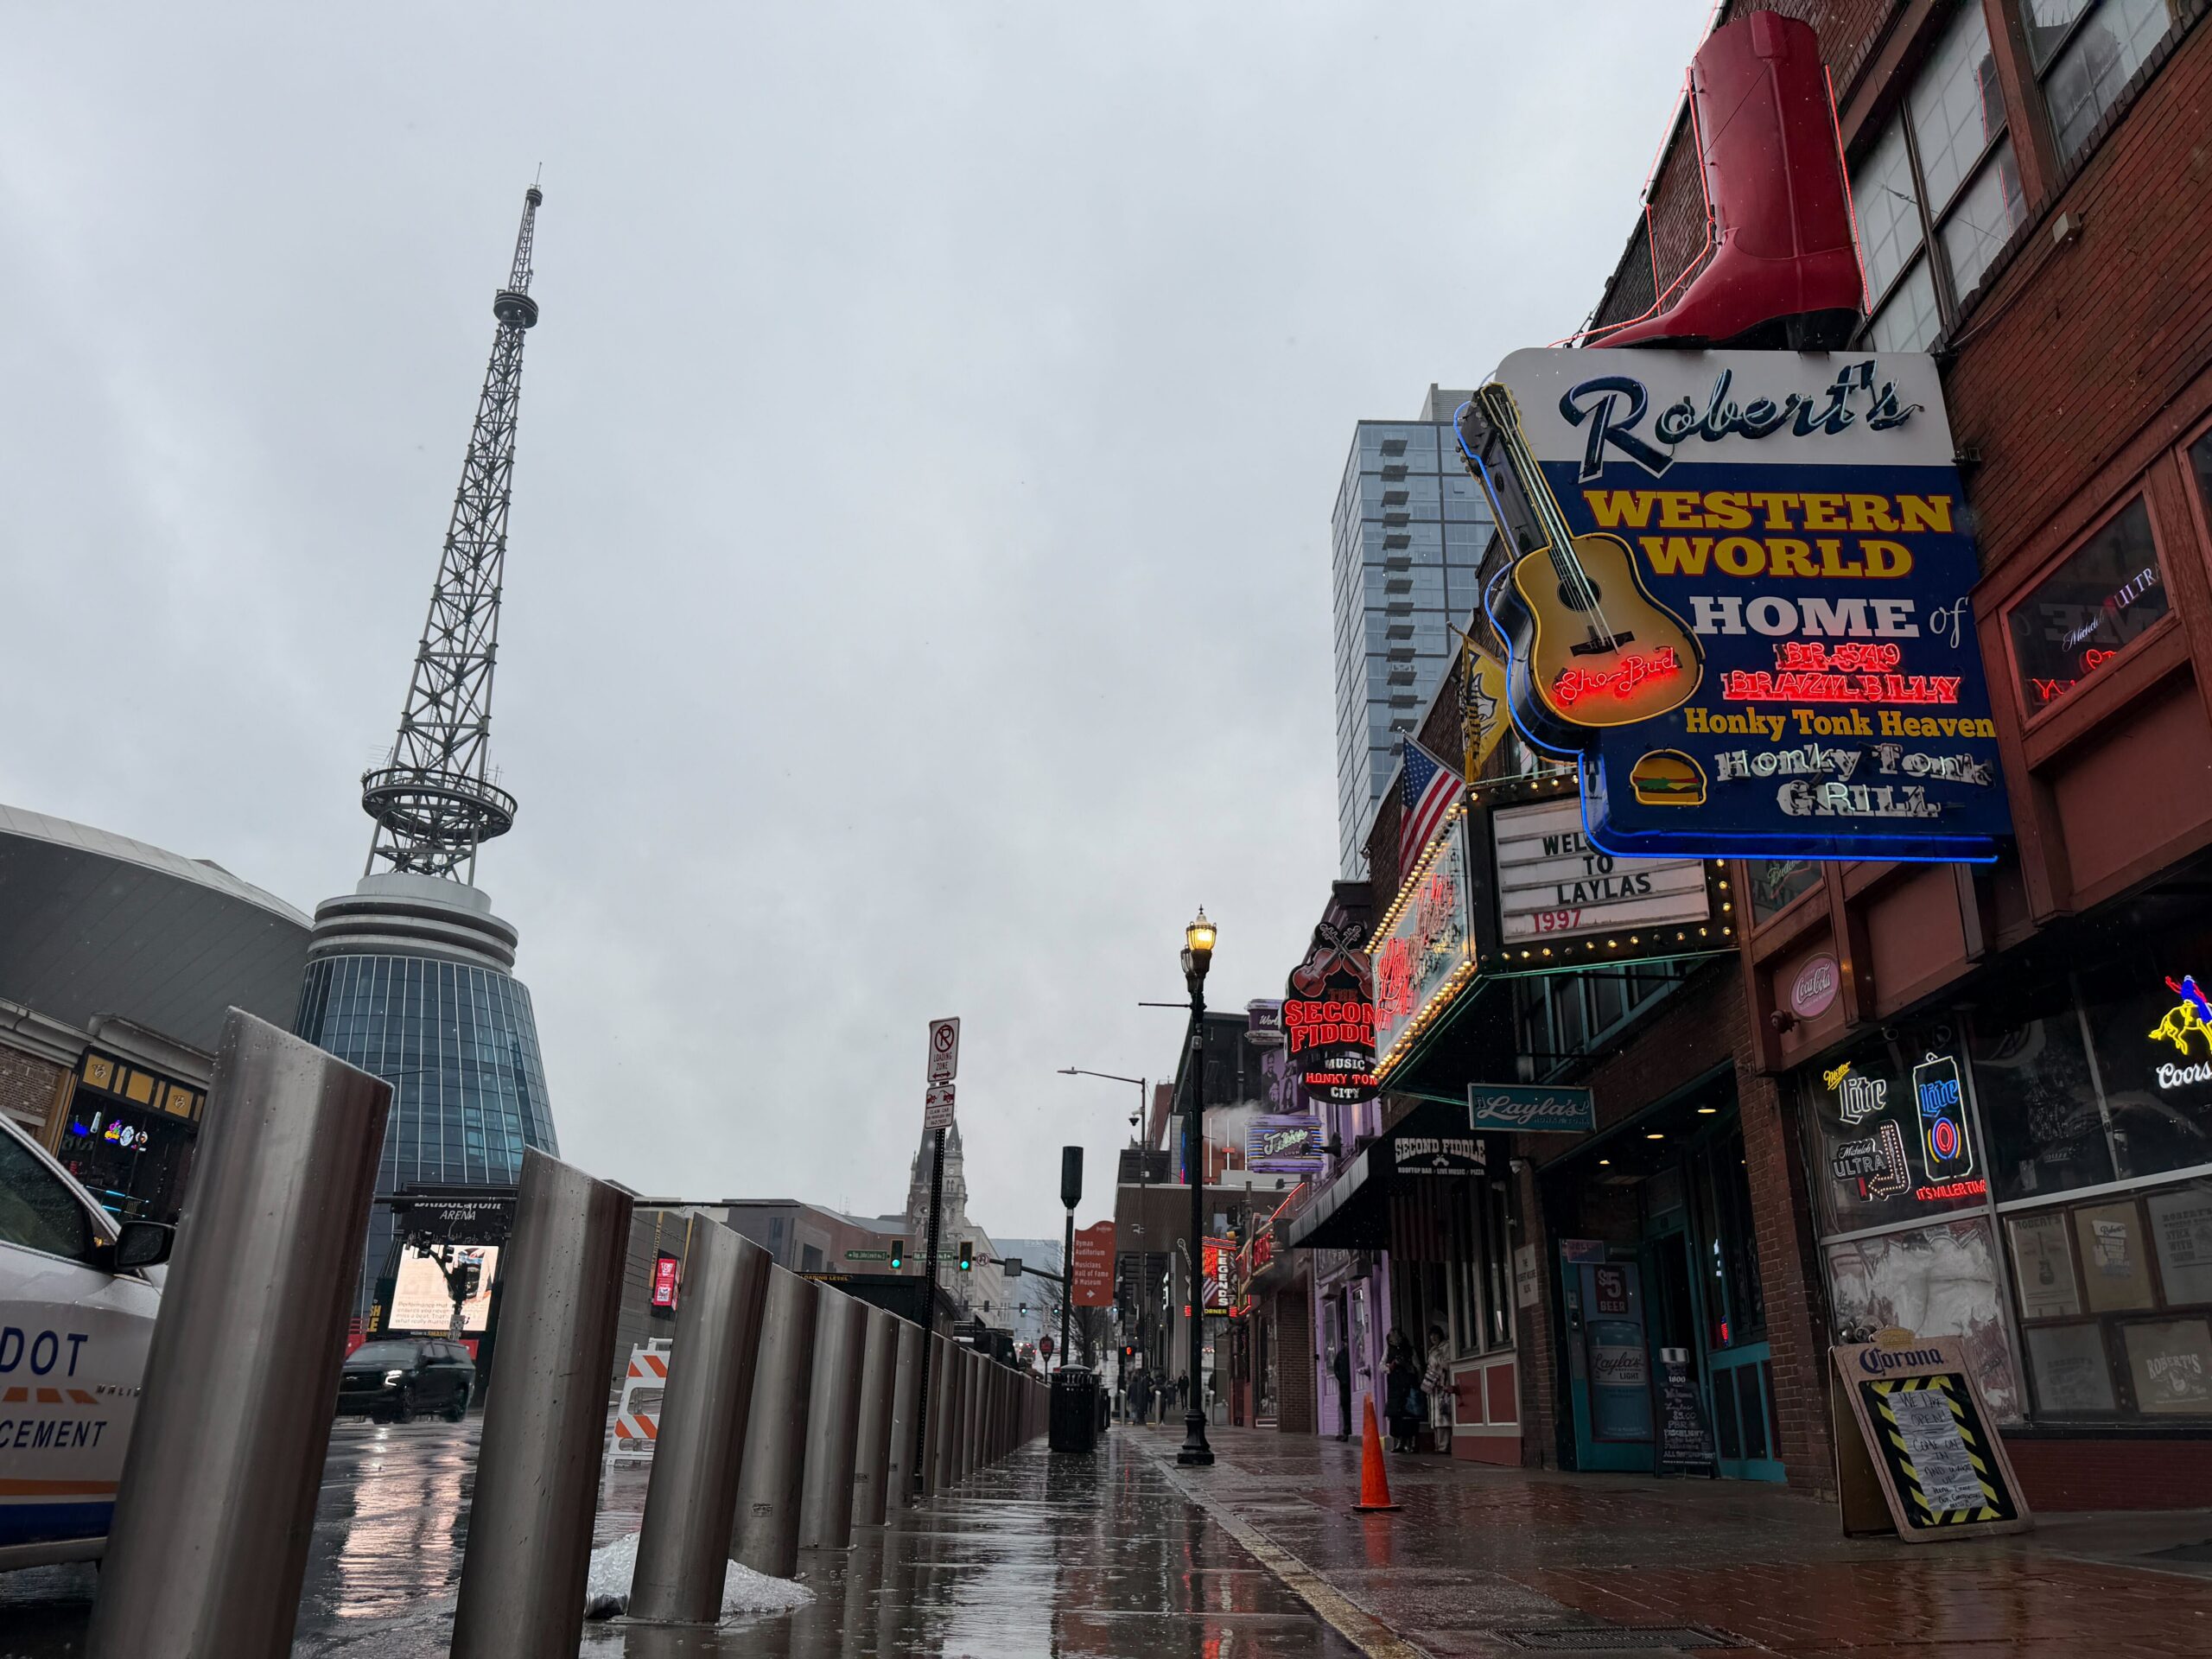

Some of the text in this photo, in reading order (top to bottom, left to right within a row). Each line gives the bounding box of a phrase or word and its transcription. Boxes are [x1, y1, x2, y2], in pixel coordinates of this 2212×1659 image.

[1559, 359, 1923, 482] Robert's
[1582, 490, 1954, 533] WESTERN
[1637, 536, 1914, 579] WORLD
[2114, 561, 2163, 609] ULTRA
[1689, 595, 1970, 648] HOME of
[1772, 641, 1904, 672] BR-549
[1553, 645, 1679, 705] Sho-Bud
[1684, 708, 1996, 741] Honky Tonk Heaven
[1714, 741, 1994, 787] Honky Tonk
[1777, 782, 1942, 818] GRILL
[1583, 855, 1613, 875] TO
[1557, 873, 1651, 905] LAYLAS
[1533, 909, 1581, 933] 1997
[1328, 988, 1357, 1001] THE
[1259, 1015, 1280, 1027] Worl
[1284, 999, 1376, 1026] SECON
[1291, 1024, 1376, 1052] FIDDL
[934, 1052, 952, 1063] LOADING
[936, 1061, 949, 1071] ZONE
[1325, 1058, 1365, 1071] MUSIC
[1306, 1072, 1377, 1085] HONKY TON
[1823, 1061, 1852, 1089] Miller
[2156, 1061, 2212, 1089] Coors
[1331, 1086, 1361, 1099] CITY
[1839, 1077, 1887, 1125] Lite
[1919, 1080, 1960, 1118] Lite
[1477, 1096, 1583, 1125] Layla's
[1395, 1137, 1486, 1166] SECOND FIDDLE
[1839, 1142, 1872, 1160] Michelob
[1833, 1154, 1887, 1178] ULTRA
[1916, 1179, 1986, 1200] IT'S MILLER TIM
[439, 1210, 476, 1220] ARENA
[2015, 1216, 2062, 1230] ROBERT'S
[1075, 1261, 1102, 1269] Musicians
[1217, 1249, 1229, 1306] LEGENDS
[1597, 1268, 1622, 1299] $5
[1599, 1300, 1625, 1313] BEER
[1595, 1351, 1640, 1376] Layla's
[1859, 1347, 1944, 1376] Corona
[2146, 1353, 2202, 1381] ROBERT'S
[95, 1384, 143, 1398] MALIB
[1910, 1410, 1947, 1427] OPEN!
[1913, 1439, 1960, 1452] COME ON
[1935, 1451, 1949, 1460] IN
[1924, 1465, 1945, 1478] AND
